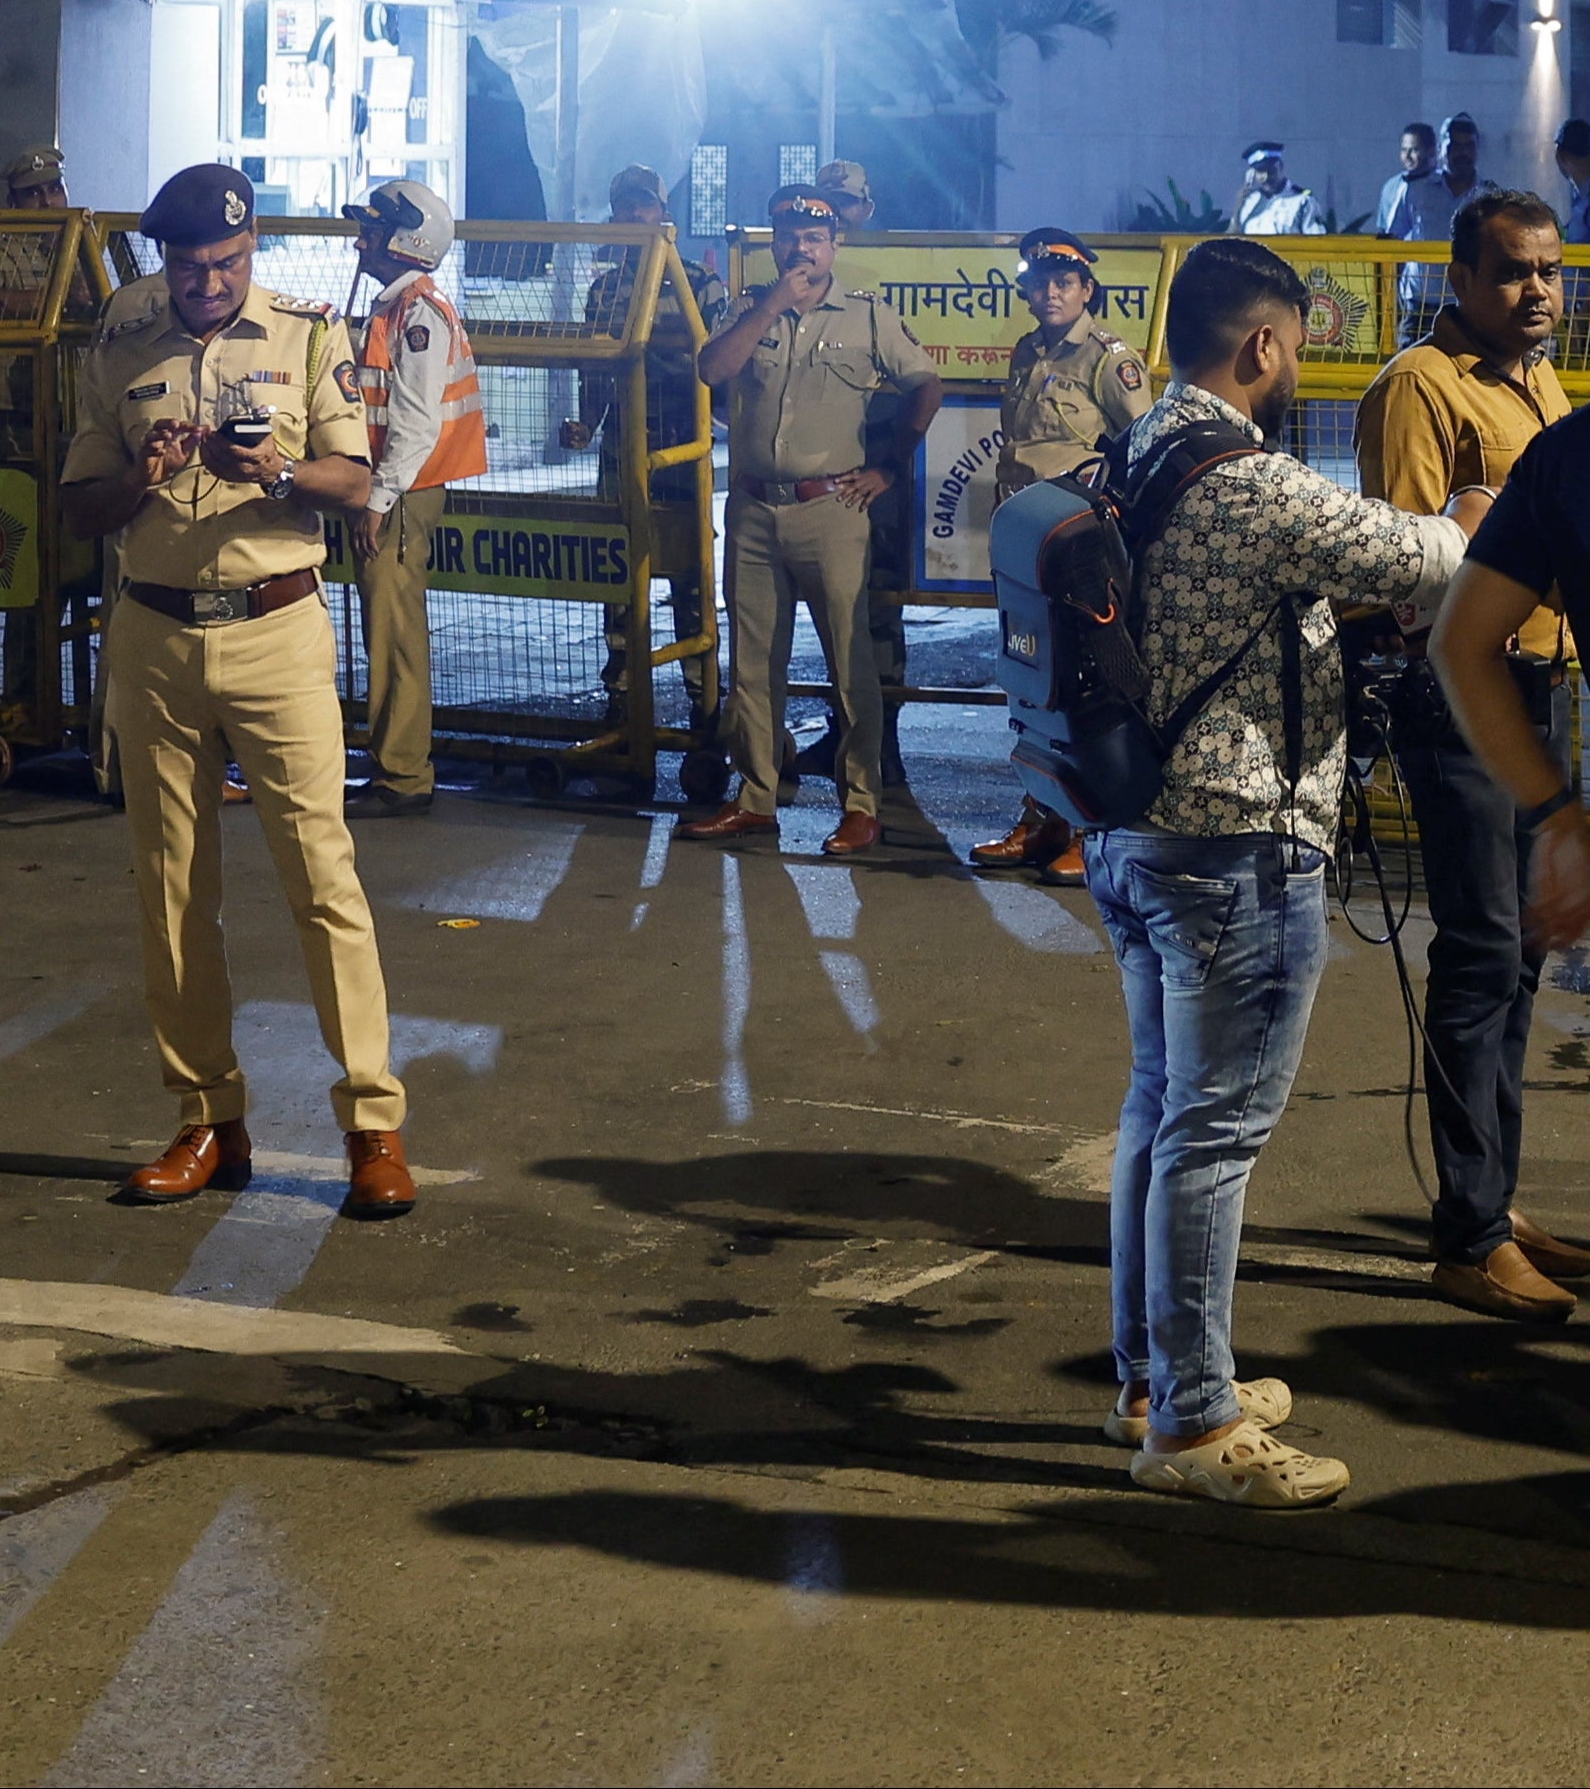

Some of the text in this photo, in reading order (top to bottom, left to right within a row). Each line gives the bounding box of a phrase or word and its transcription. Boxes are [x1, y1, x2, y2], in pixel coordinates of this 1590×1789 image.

[880, 268, 1014, 318] गामदेवी
[932, 447, 984, 539] GAMDEVI
[472, 527, 628, 585] CHARITIES
